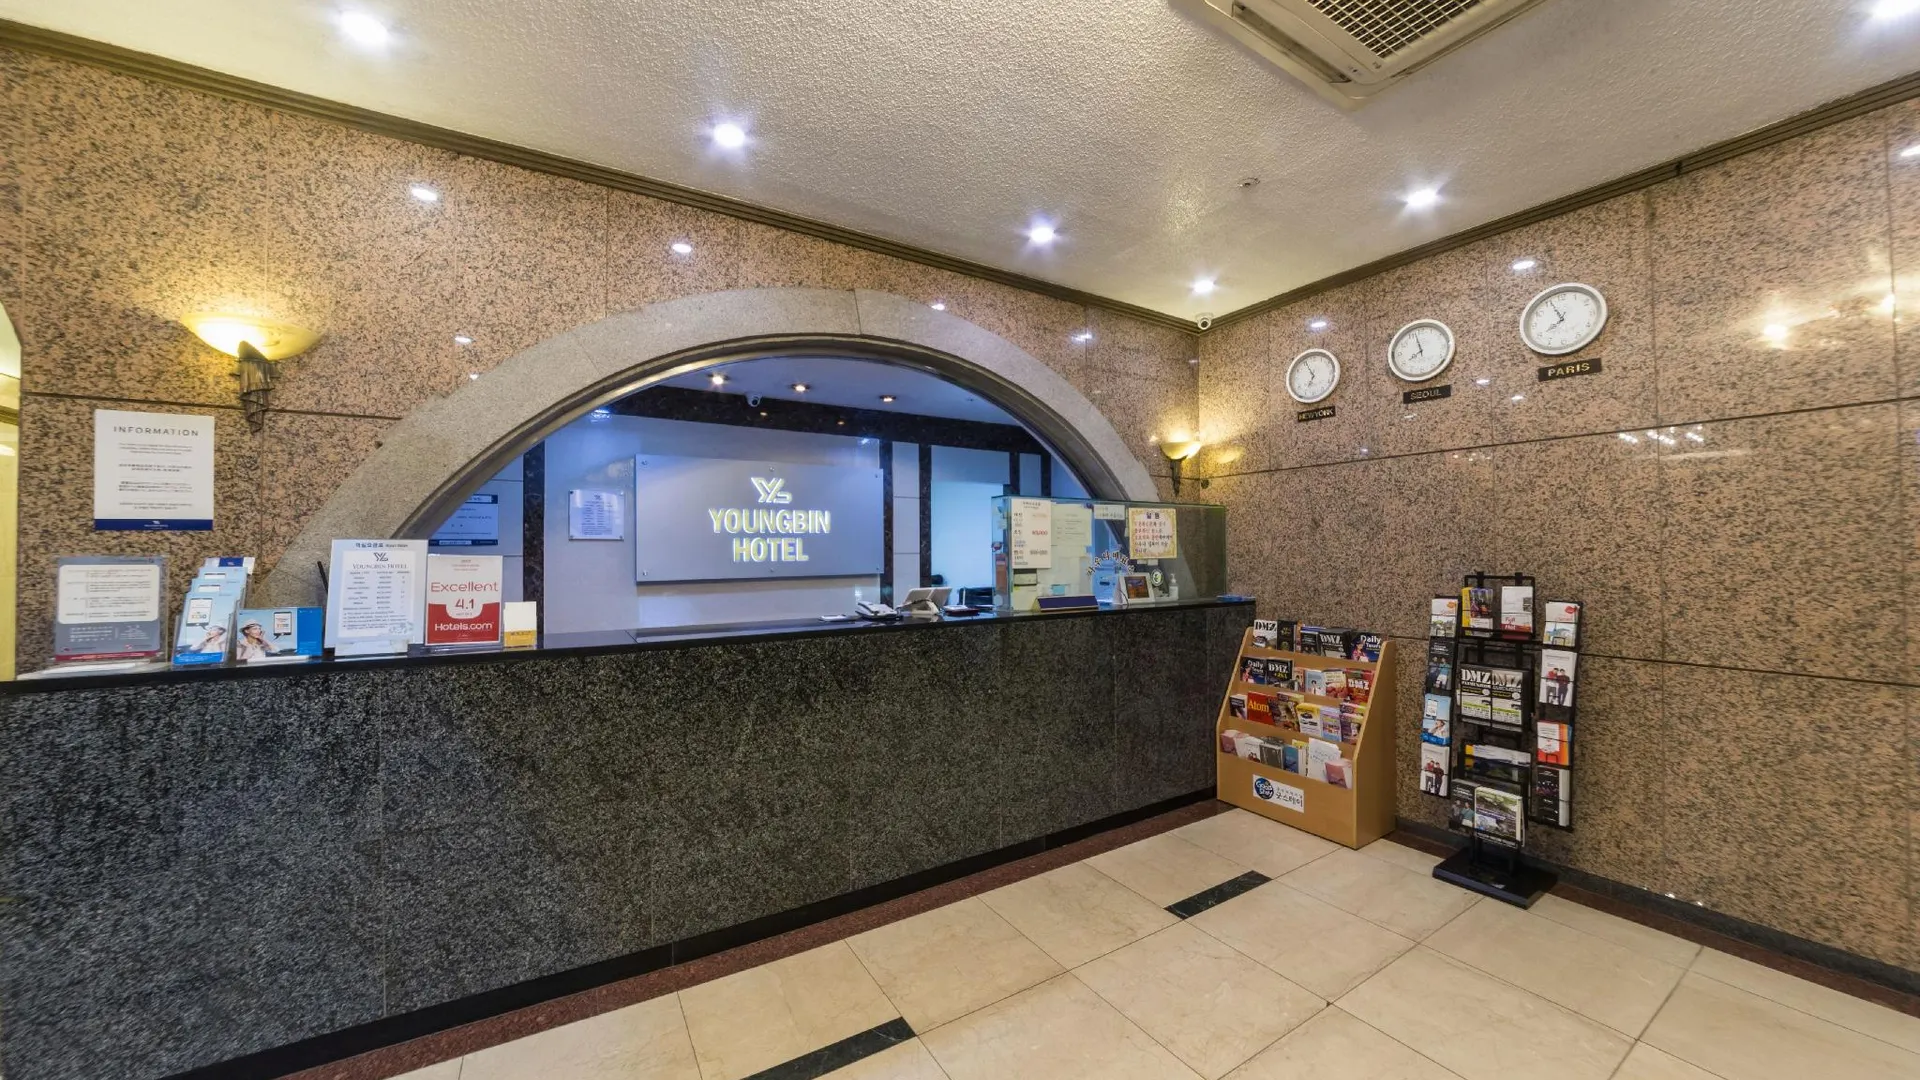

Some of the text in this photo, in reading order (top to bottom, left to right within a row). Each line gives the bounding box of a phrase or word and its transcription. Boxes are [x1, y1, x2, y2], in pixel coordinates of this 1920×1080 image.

[1547, 362, 1591, 377] PARIS
[1410, 389, 1442, 401] SEOUL
[113, 426, 199, 437] INFORMATION
[708, 507, 831, 534] YOUNGBIN
[733, 537, 809, 562] HOTEL
[430, 581, 499, 593] Excellent
[455, 598, 475, 610] 4.1
[434, 622, 493, 632] Hotels.com
[1255, 621, 1277, 631] DMZ
[1360, 634, 1381, 646] Daily
[1247, 660, 1264, 669] Daily
[1268, 662, 1288, 673] DMZ
[1461, 668, 1491, 684] DMZ
[1347, 678, 1370, 690] DMZ
[1248, 700, 1269, 713] Atom
[1276, 790, 1303, 808] 굿스테이
